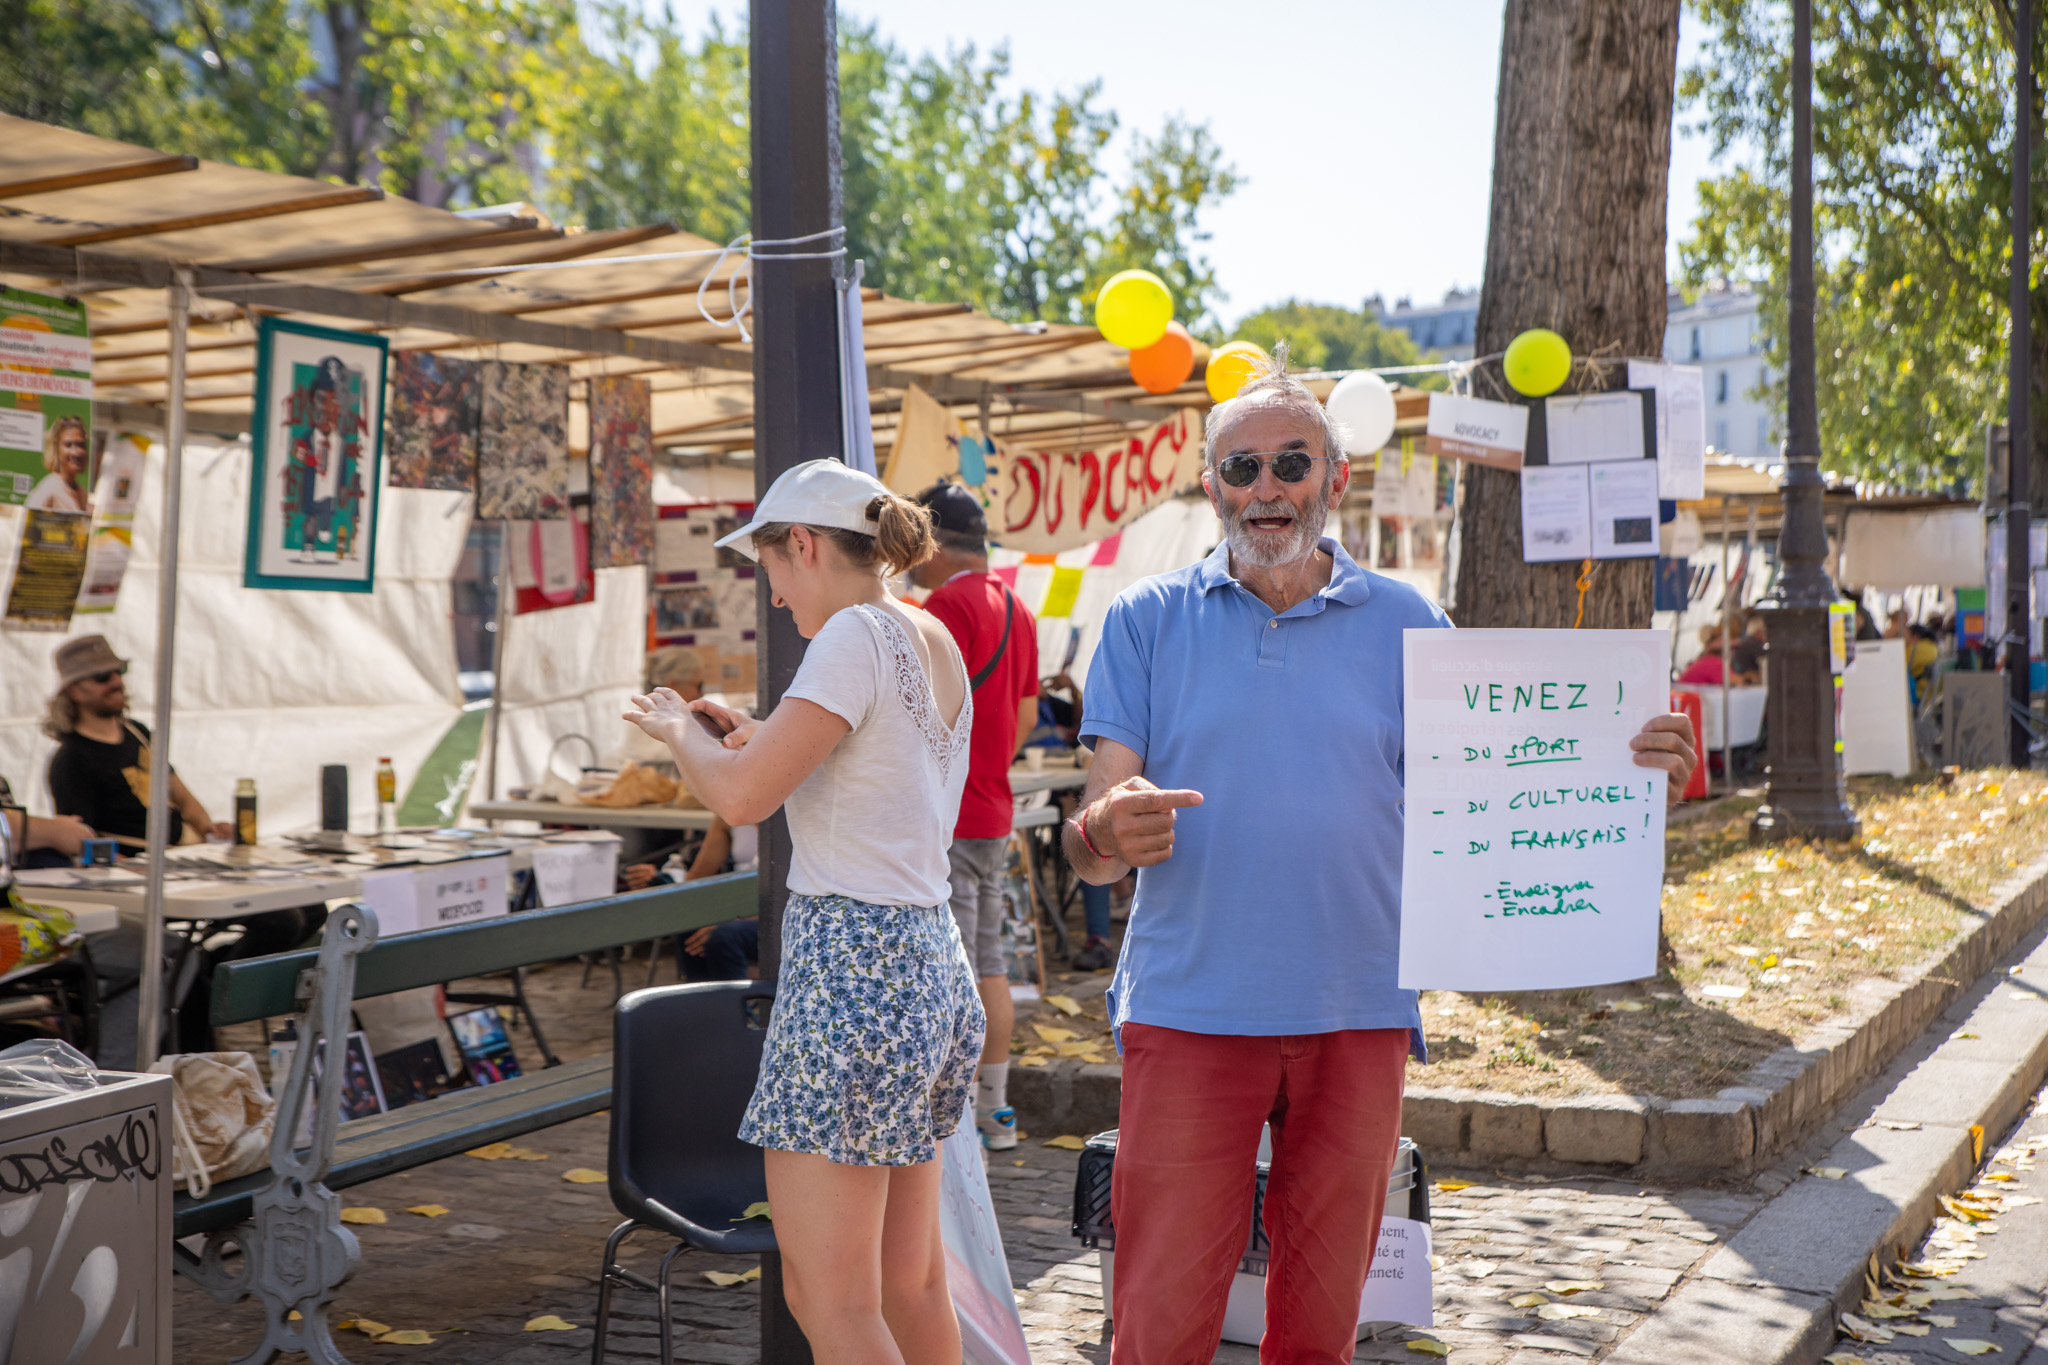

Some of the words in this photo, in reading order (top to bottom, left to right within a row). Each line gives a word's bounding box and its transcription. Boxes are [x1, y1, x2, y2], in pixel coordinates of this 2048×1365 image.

[1454, 422, 1499, 441] ADVOCACY
[1464, 683, 1588, 712] VENEZ
[1464, 747, 1491, 761] DU
[1504, 736, 1580, 759] SPORT
[1467, 800, 1488, 813] DU
[1468, 840, 1490, 855] DU
[1393, 1248, 1405, 1259] et
